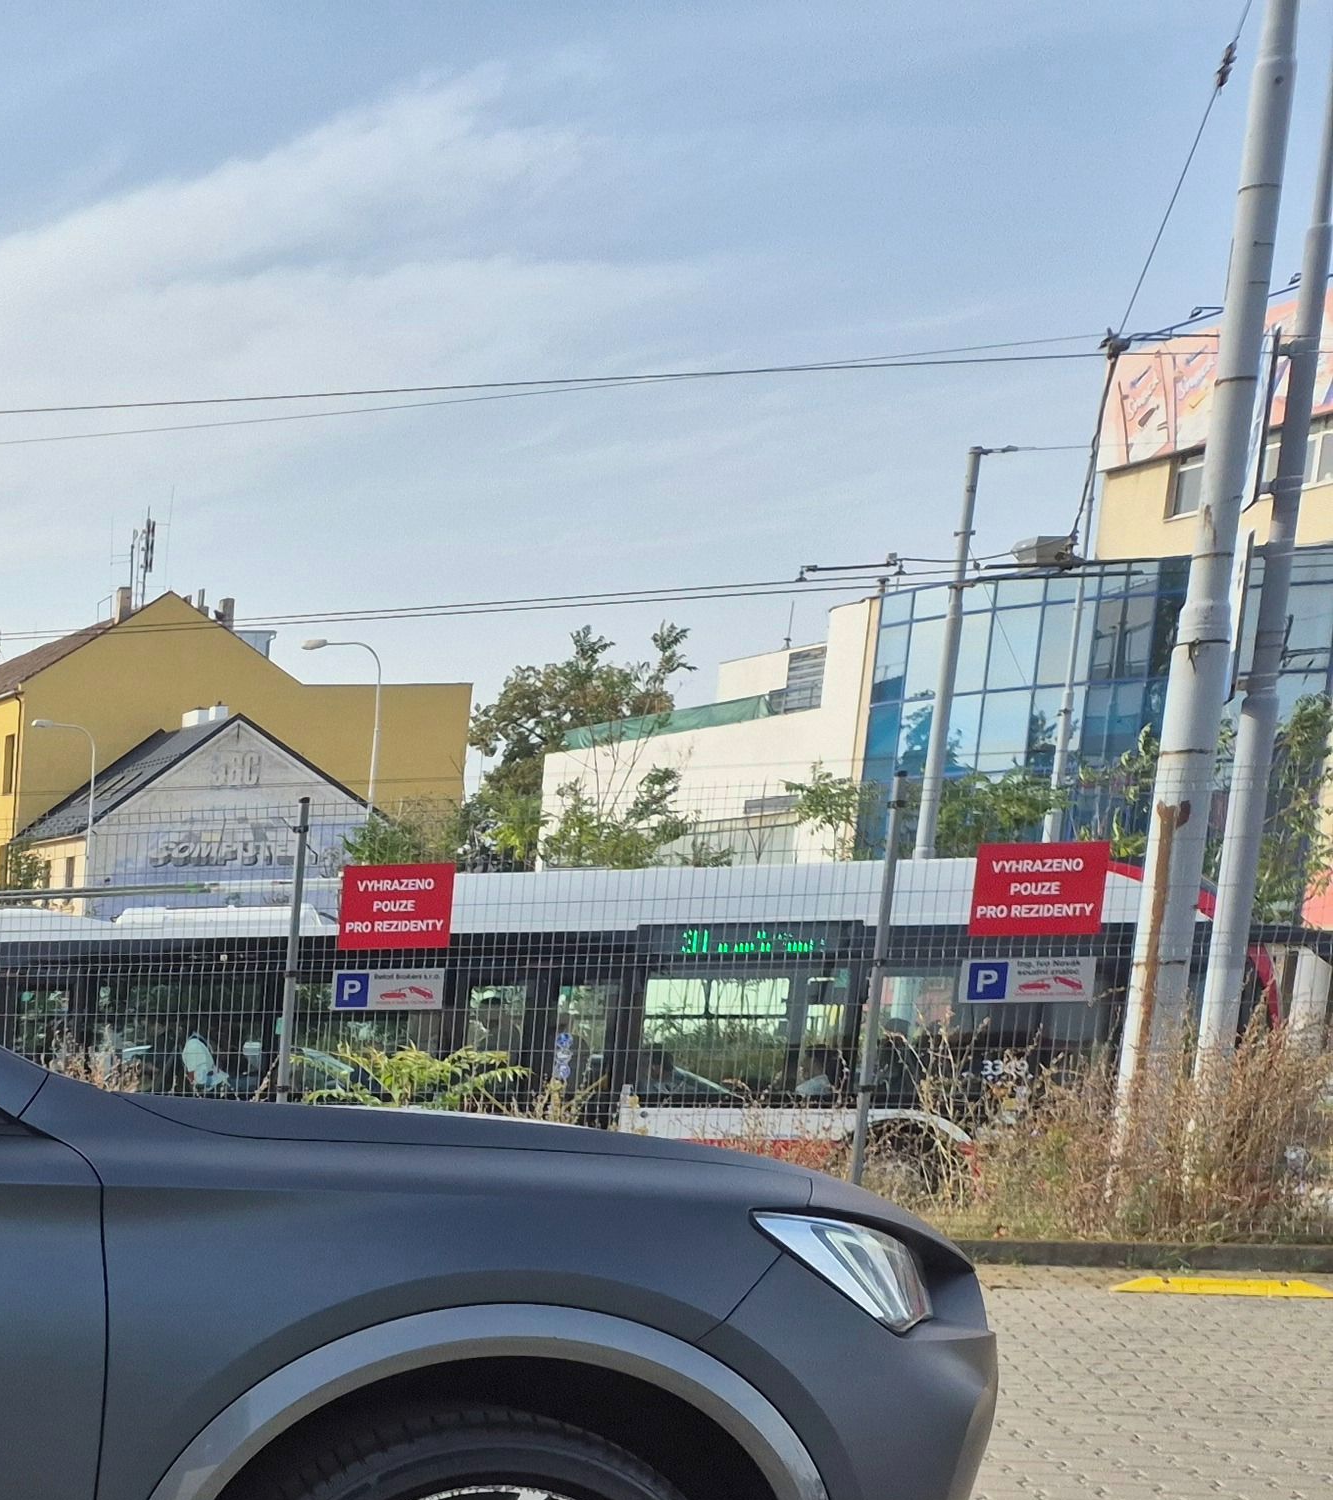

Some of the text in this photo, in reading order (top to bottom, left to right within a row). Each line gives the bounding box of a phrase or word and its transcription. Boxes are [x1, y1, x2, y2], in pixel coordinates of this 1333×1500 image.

[992, 858, 1083, 873] VYHRAZENO
[357, 878, 434, 892] VYHRAZENO
[1010, 882, 1061, 895] POUZE
[373, 900, 415, 912] POUZE
[976, 903, 1094, 919] PRO REZIDENTY
[345, 920, 443, 933] PRO REZIDENTY
[976, 969, 999, 993] P
[343, 979, 361, 1001] P
